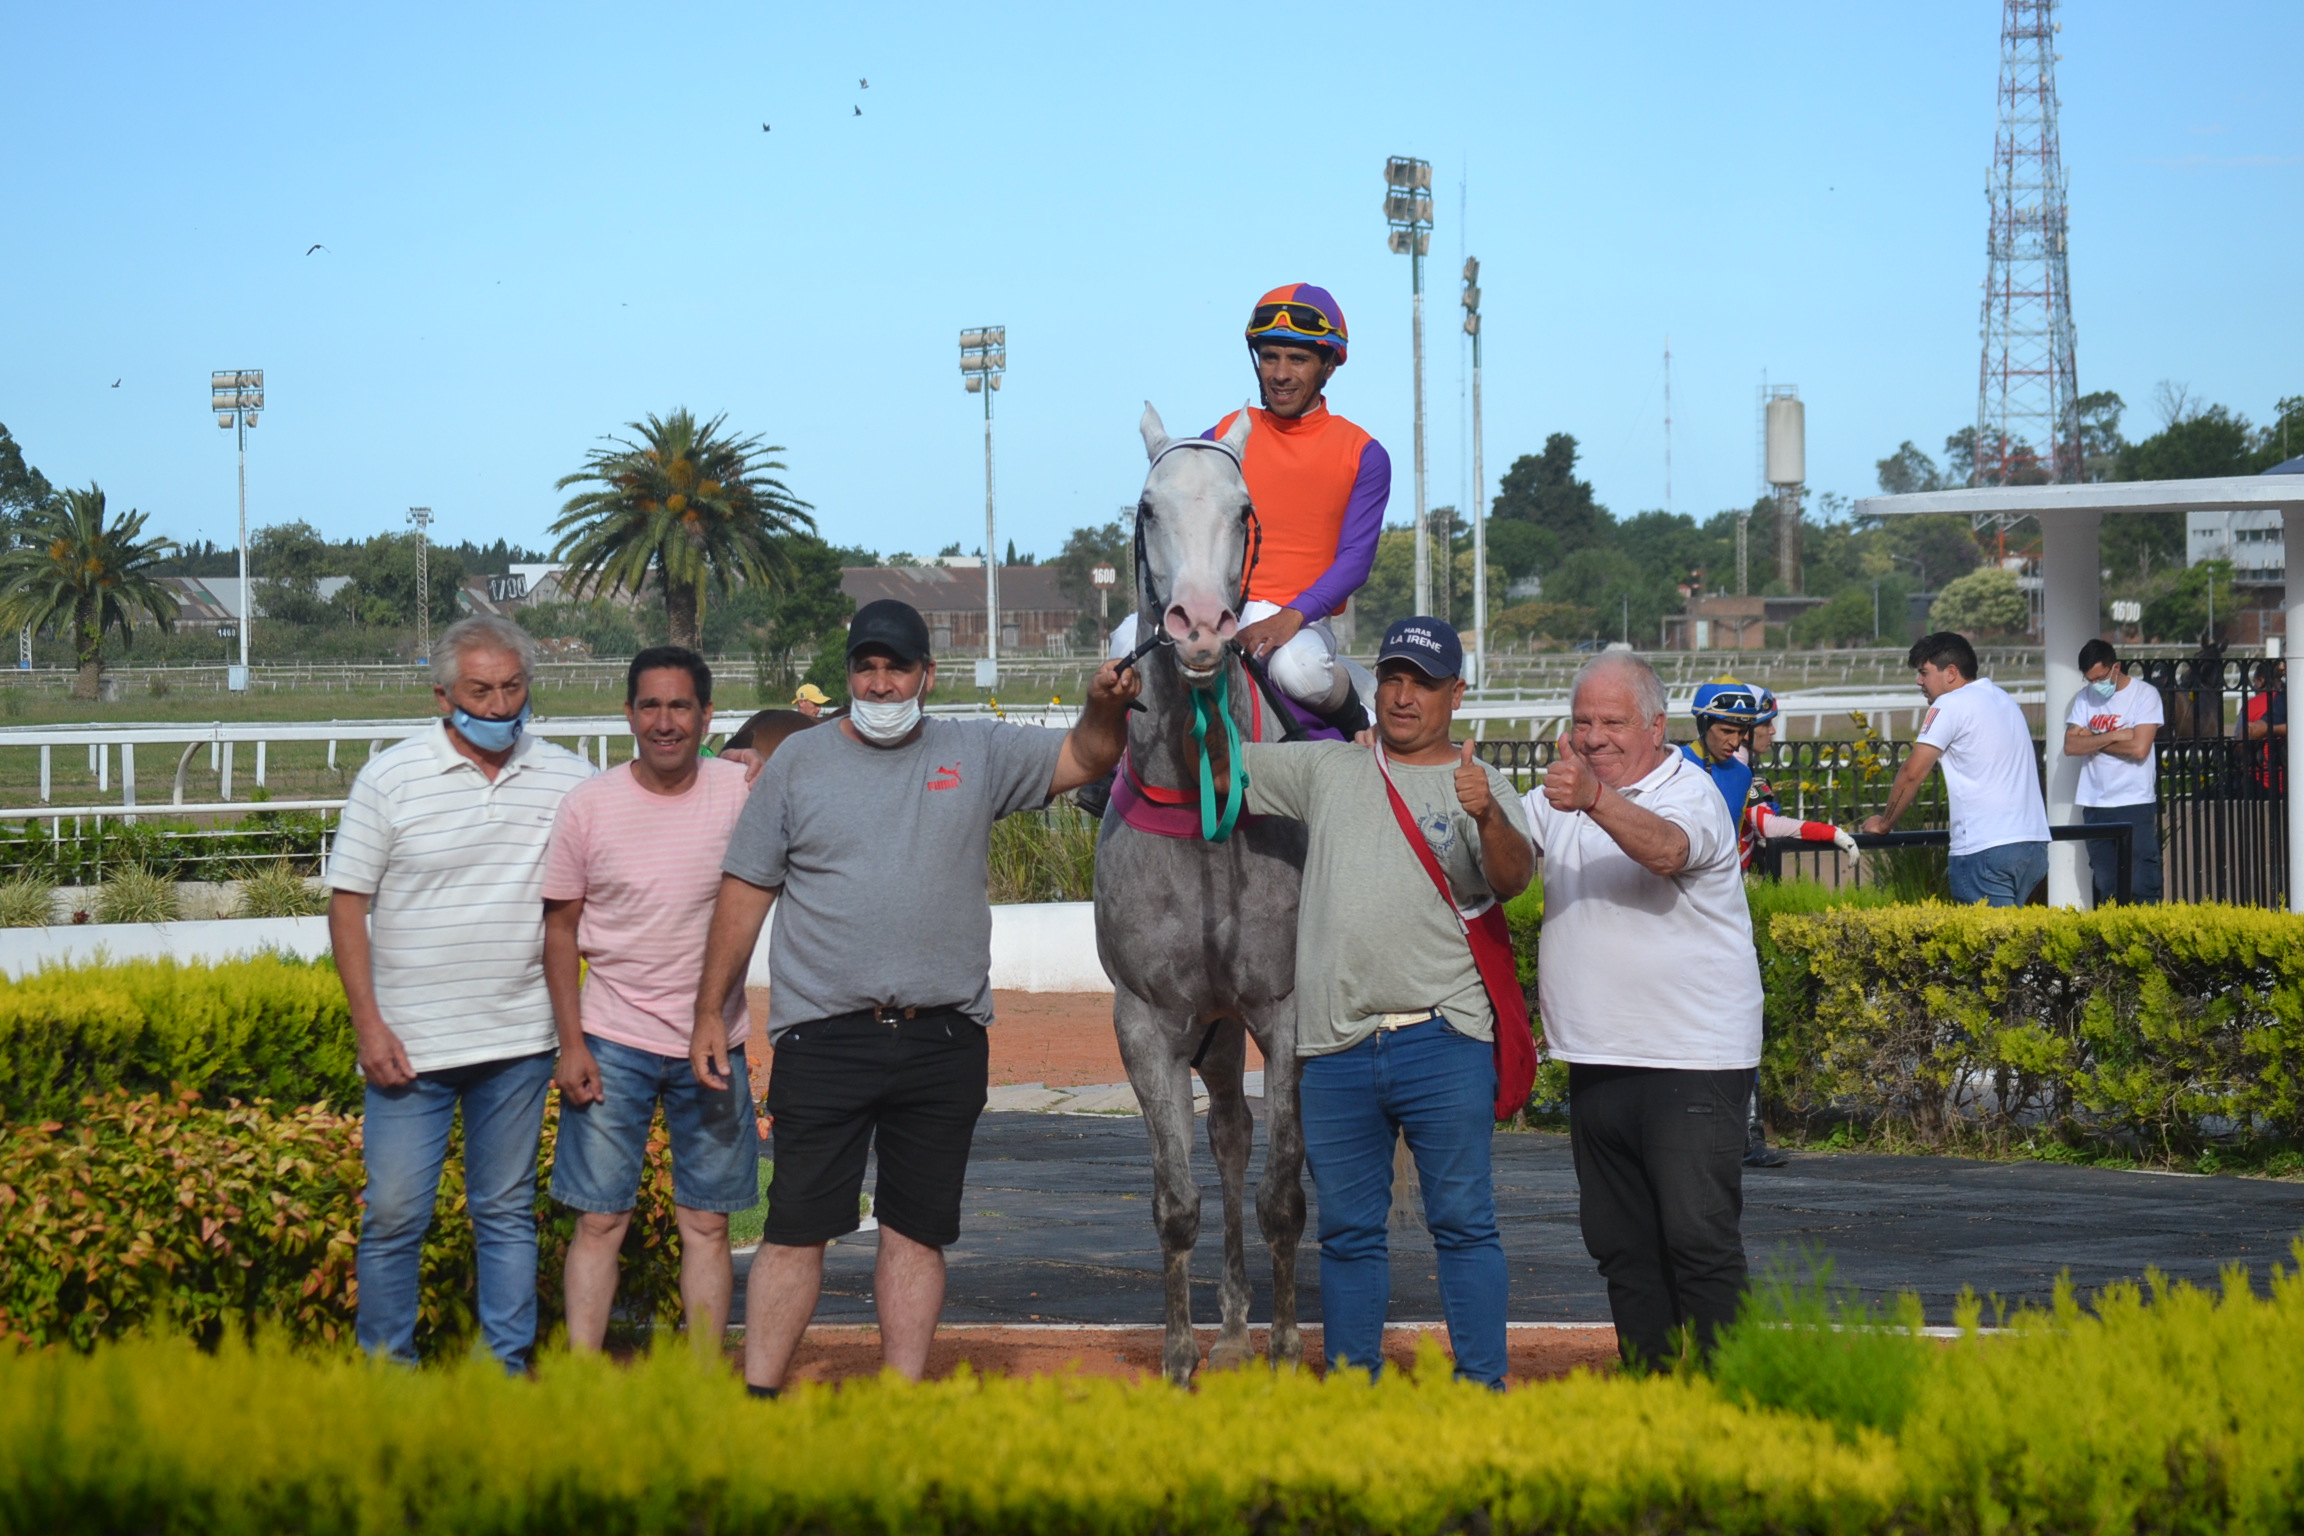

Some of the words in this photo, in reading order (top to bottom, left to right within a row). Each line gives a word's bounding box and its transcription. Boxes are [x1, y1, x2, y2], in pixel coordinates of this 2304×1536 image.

[1092, 568, 1116, 584] 1600
[2111, 600, 2141, 622] 1600
[1404, 627, 1432, 637] HARAS
[1389, 635, 1403, 645] LA
[1406, 634, 1442, 653] IRENE
[2089, 714, 2121, 732] NIKE
